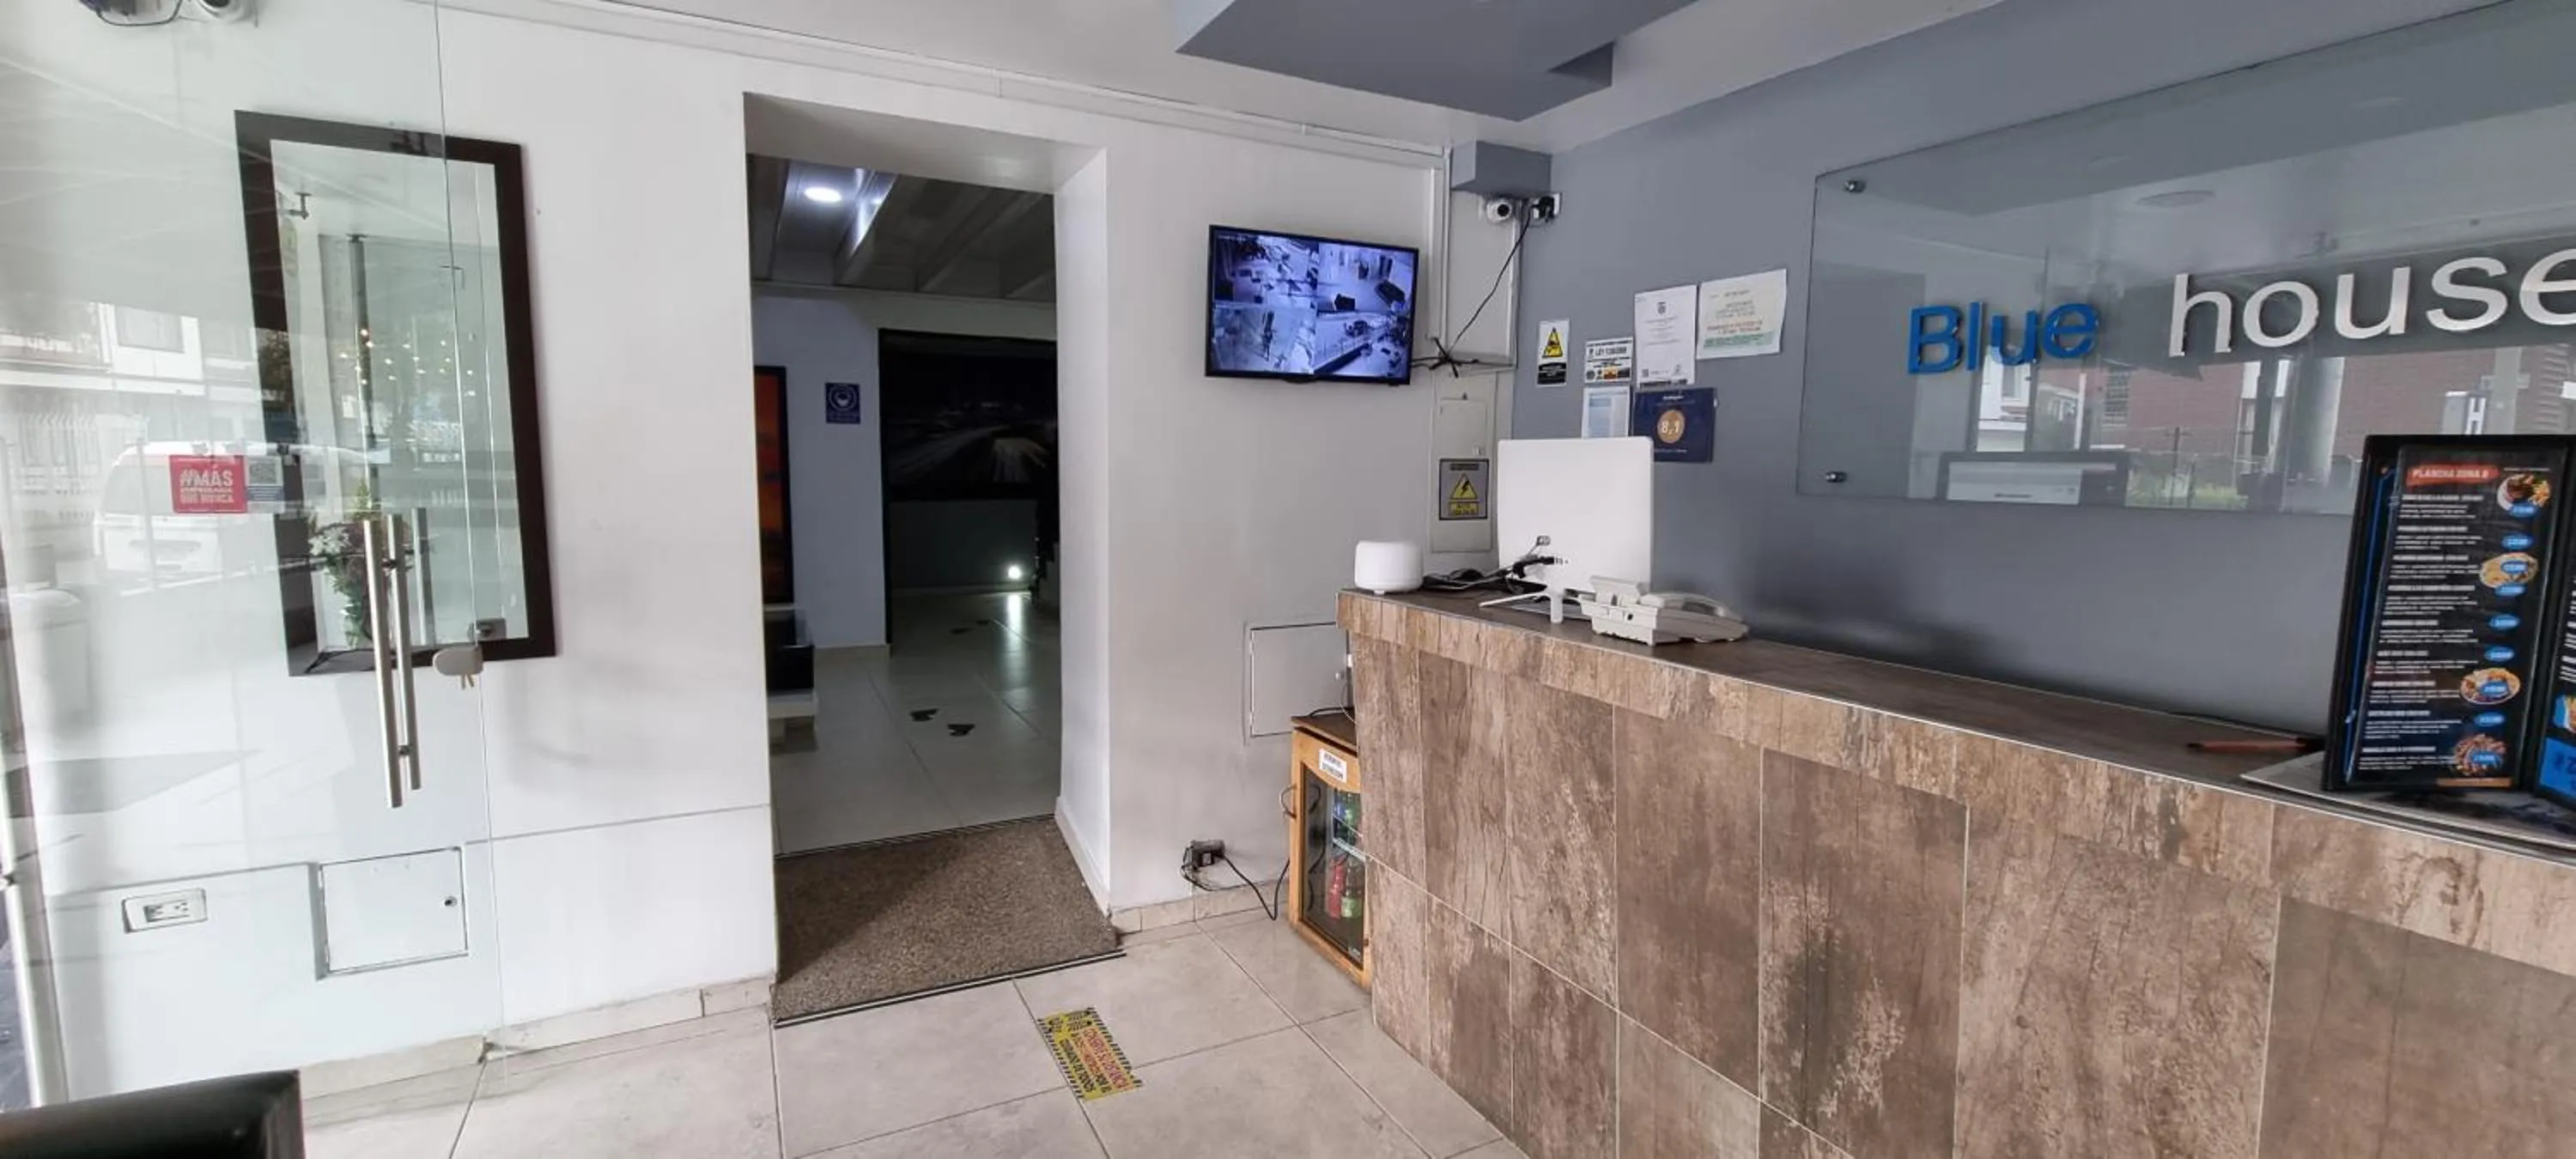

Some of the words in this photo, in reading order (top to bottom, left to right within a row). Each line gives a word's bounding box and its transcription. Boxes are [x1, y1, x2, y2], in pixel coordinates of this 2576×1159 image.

[1907, 300, 2099, 375] Blue
[2168, 249, 2576, 358] house
[1662, 421, 1680, 434] 8,1
[179, 464, 234, 487] #MÁS
